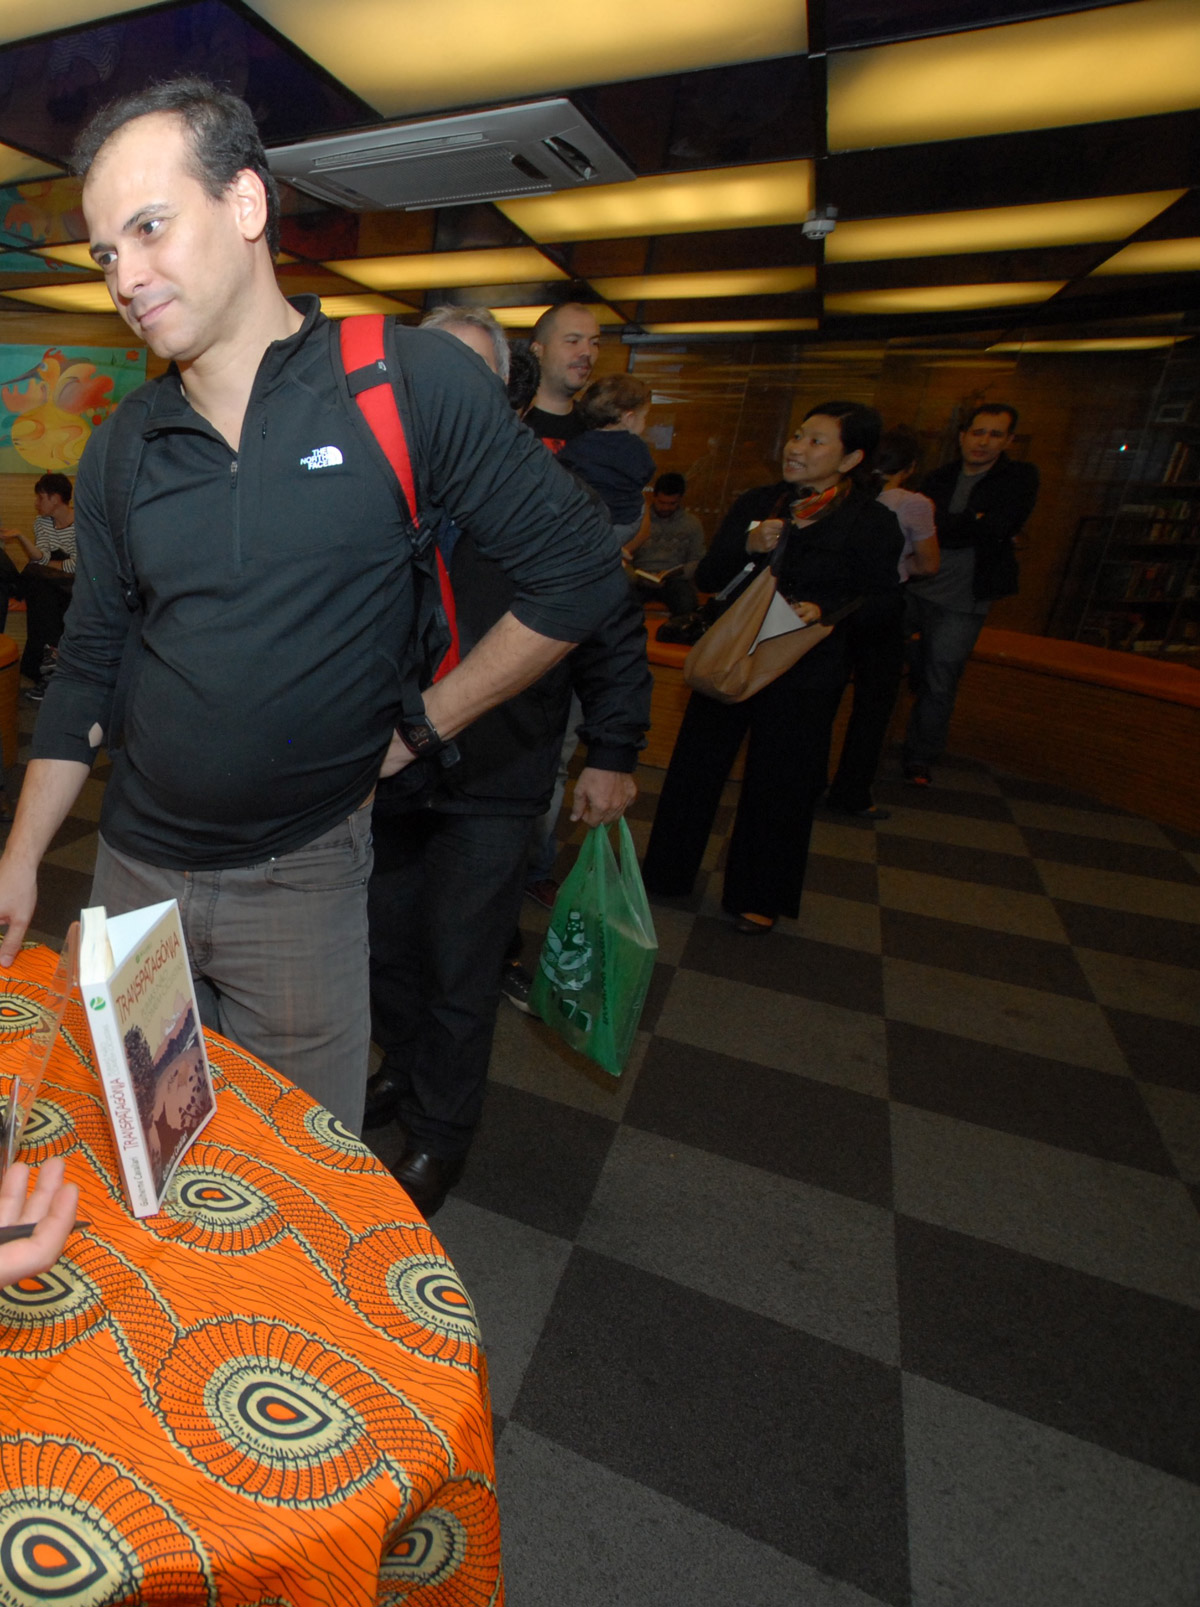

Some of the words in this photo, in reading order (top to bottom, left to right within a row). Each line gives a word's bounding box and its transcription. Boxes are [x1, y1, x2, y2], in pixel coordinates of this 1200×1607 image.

[312, 447, 328, 457] THE
[300, 454, 328, 465] NORTH
[308, 460, 328, 470] FACE
[115, 931, 180, 1025] TRANSPATAGÔNIA
[110, 1078, 139, 1151] TRANSPATAGÔNIA
